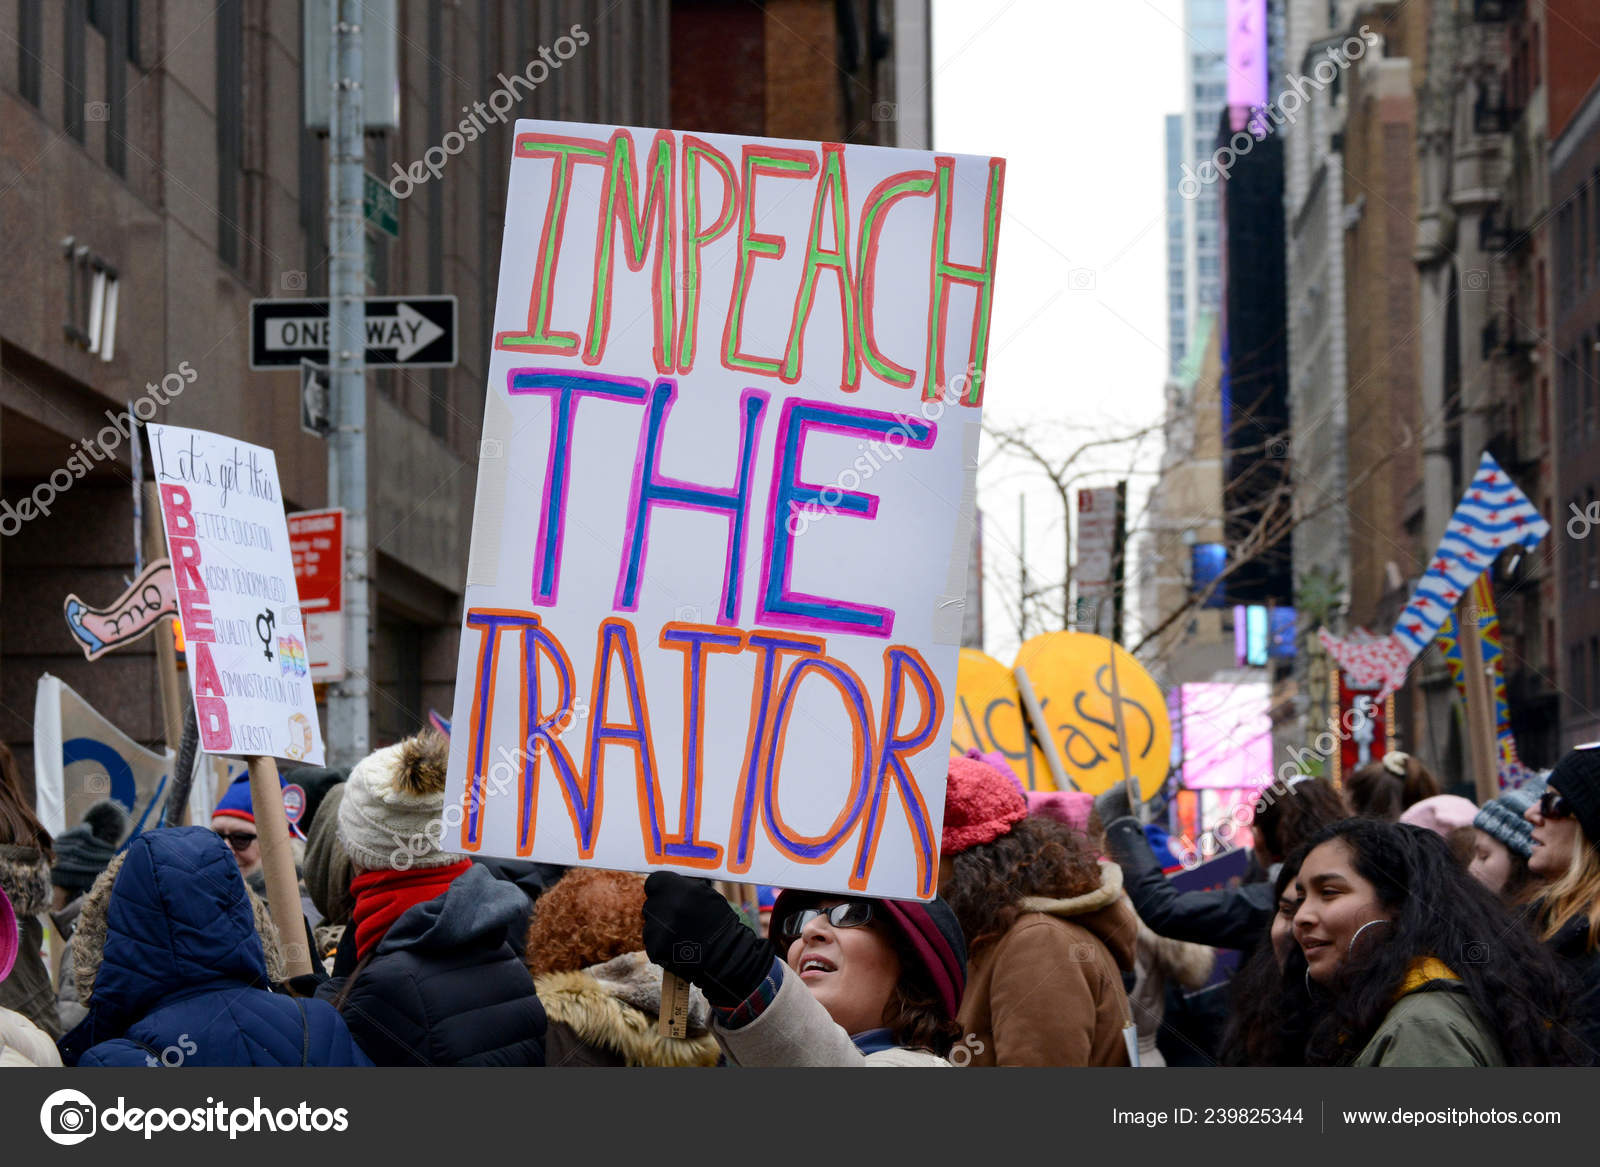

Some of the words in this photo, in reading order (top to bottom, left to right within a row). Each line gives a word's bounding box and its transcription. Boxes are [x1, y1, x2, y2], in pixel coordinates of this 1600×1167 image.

[365, 319, 423, 345] WAY
[494, 129, 1006, 407] IMPEACH
[153, 427, 216, 487] Let's
[220, 446, 243, 508] get
[246, 450, 277, 503] this
[229, 517, 273, 553] EDUCATION
[506, 367, 936, 639] THE
[461, 608, 945, 899] TRAITOR
